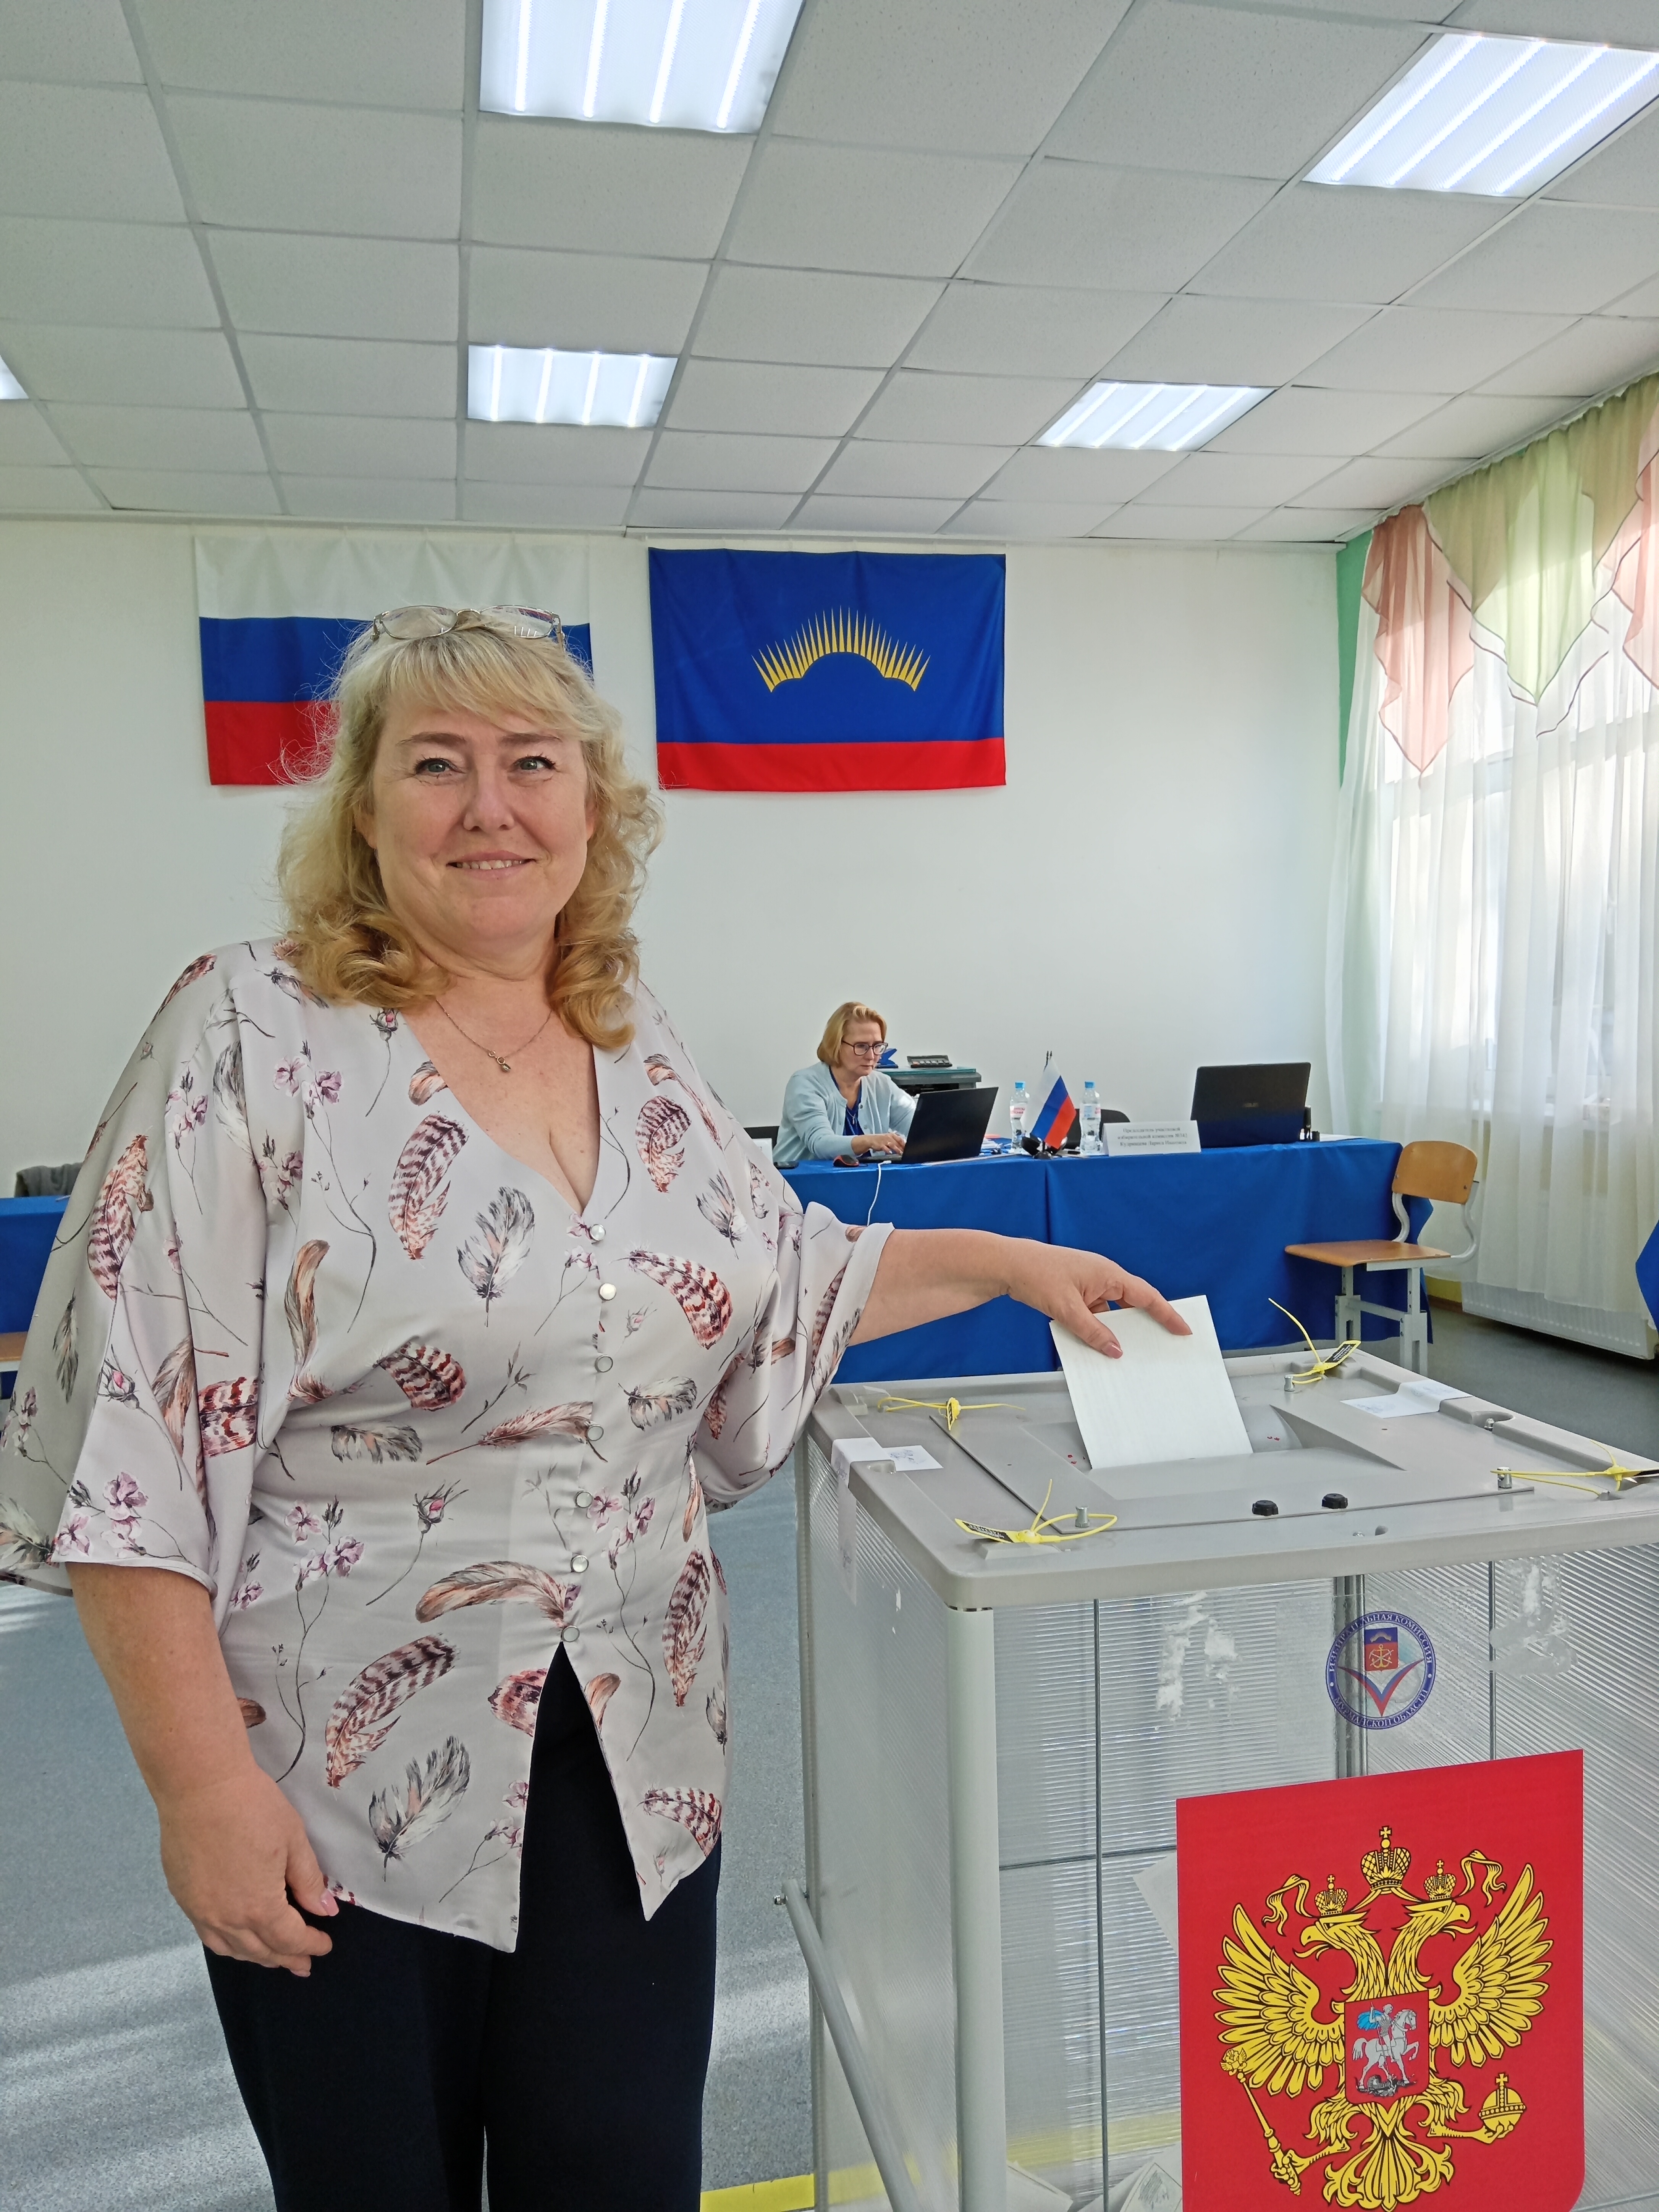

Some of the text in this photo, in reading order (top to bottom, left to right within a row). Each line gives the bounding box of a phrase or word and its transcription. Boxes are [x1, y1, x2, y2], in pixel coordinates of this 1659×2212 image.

[1329, 1614, 1433, 1672] ИЗБИРАТЕЛЬНАЯ КОМИССИЯ
[1334, 1688, 1428, 1727] МУРМАНСКОЙ ОБЛАСТИ
